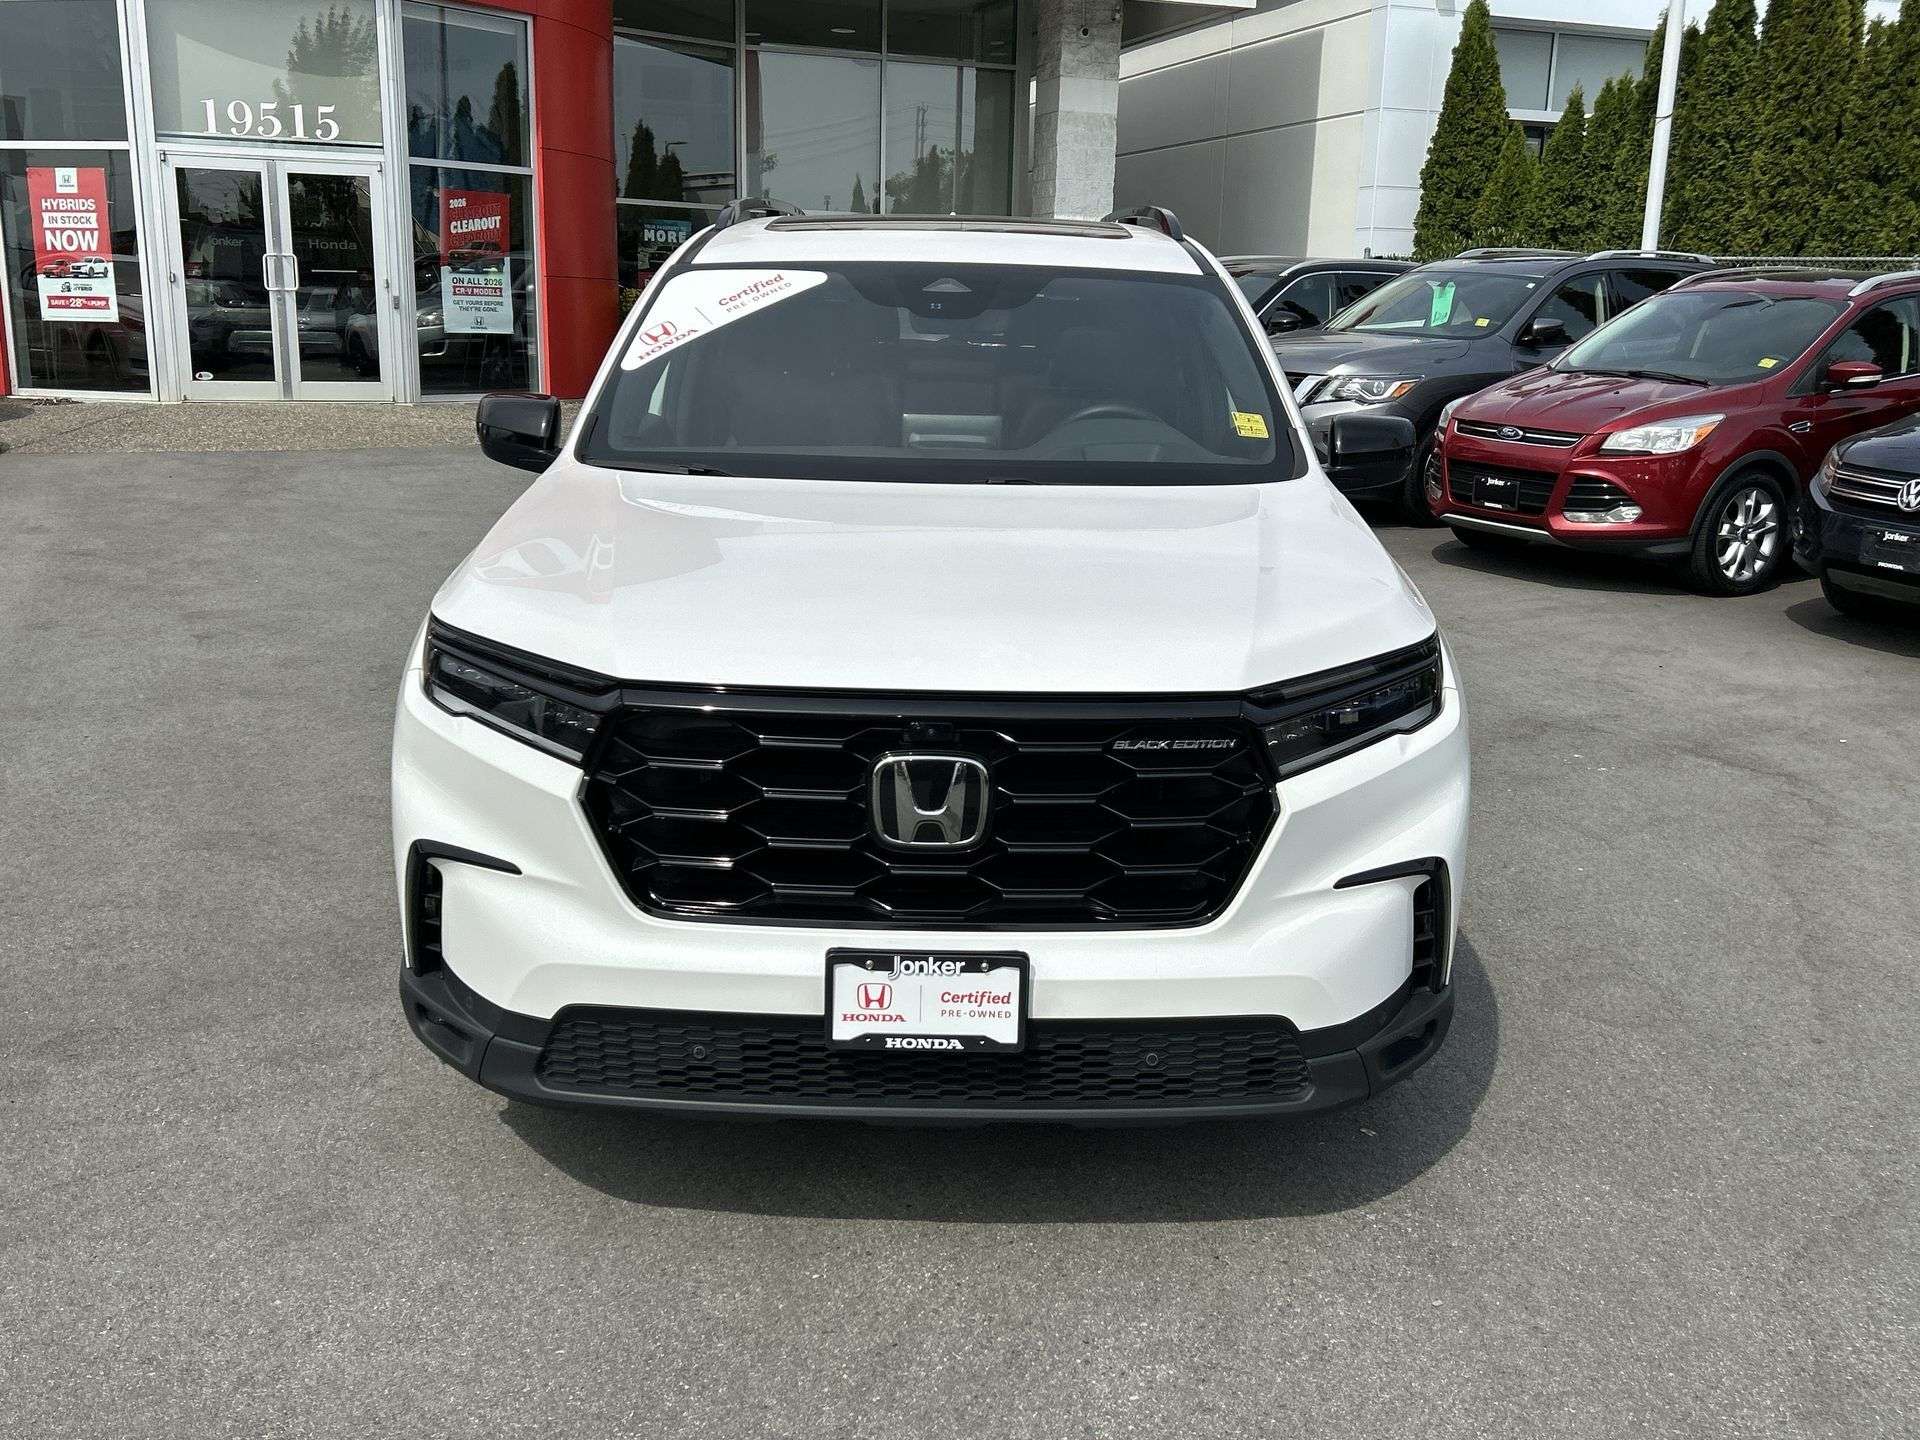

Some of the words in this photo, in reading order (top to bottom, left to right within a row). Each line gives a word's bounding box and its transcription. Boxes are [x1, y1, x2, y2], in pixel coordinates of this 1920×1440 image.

[200, 99, 340, 140] 19515
[41, 198, 96, 211] HYBRIDS
[449, 198, 467, 209] 2026
[48, 216, 58, 225] IN
[60, 216, 92, 225] STOCK
[450, 215, 502, 234] CLEAROUT
[45, 229, 99, 252] NOW
[644, 229, 688, 244] MORE
[308, 238, 358, 250] Honda
[452, 276, 465, 285] ON
[467, 277, 482, 285] ALL
[484, 278, 503, 287] 2026
[455, 287, 472, 295] CR-V
[473, 287, 501, 296] MODELS
[718, 274, 785, 306] Certified
[726, 282, 793, 313] PRE-OWNED
[637, 328, 699, 361] HONDA
[1112, 740, 1172, 750] BLACK
[1172, 739, 1237, 750] EDITION
[887, 955, 966, 980] Jonker
[941, 991, 1012, 1007] Certified
[841, 1013, 907, 1023] HONDA
[941, 1009, 1012, 1019] PRE-OWNED
[884, 1037, 965, 1050] HONDA
